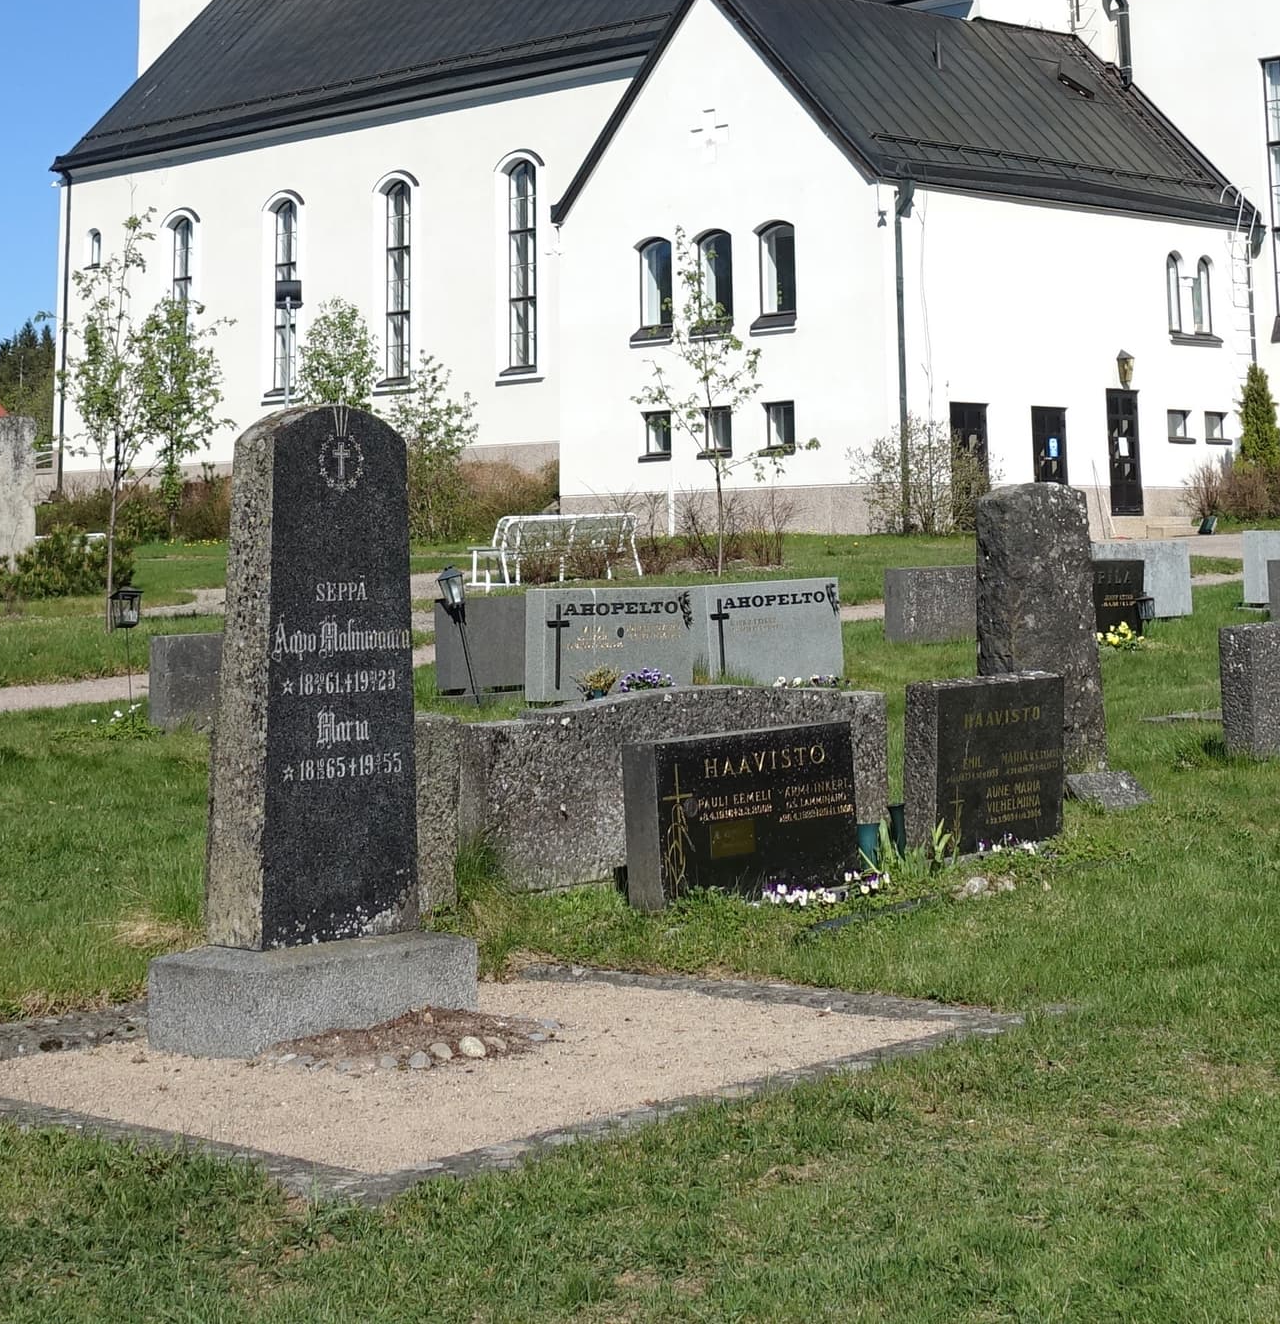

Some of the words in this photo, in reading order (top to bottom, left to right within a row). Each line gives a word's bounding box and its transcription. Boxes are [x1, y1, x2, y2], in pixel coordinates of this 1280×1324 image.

[316, 575, 368, 602] SEPPÄ
[723, 592, 825, 610] AHOPELTO
[563, 600, 679, 616] AHOPELTO
[272, 612, 317, 662] Aapo
[316, 704, 370, 750] Maria
[964, 706, 1041, 729] HAAVISTO
[704, 744, 826, 779] HAAVISTO
[697, 795, 729, 812] PAULI
[733, 789, 772, 806] EEMELI
